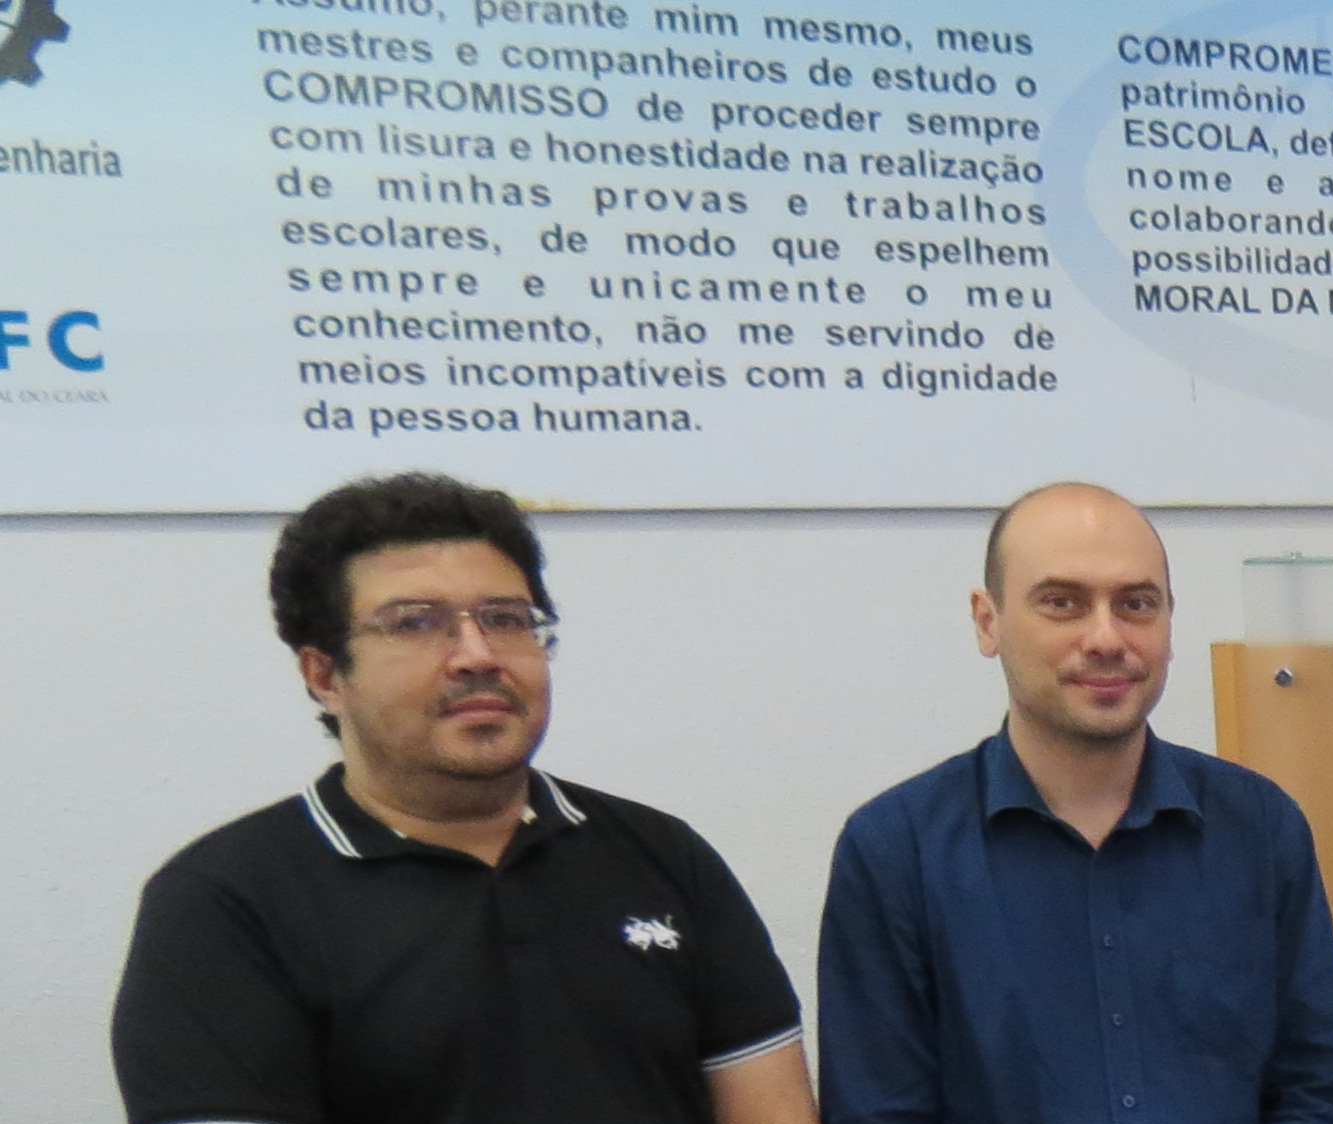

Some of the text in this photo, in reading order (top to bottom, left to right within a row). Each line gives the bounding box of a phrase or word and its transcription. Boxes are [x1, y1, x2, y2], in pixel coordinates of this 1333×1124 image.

[475, 0, 628, 29] perante
[655, 4, 738, 36] mim
[764, 17, 912, 51] mesmo,
[937, 28, 1033, 55] meus
[258, 29, 1037, 98] mestres e companheiros de estudo o
[263, 69, 1040, 145] COMPROMISSO de proceder sempre
[1121, 81, 1305, 115] patrimônio
[270, 124, 1043, 189] com lisura e honestidade na realização
[1124, 118, 1278, 158] ESCOLA,
[276, 166, 1046, 225] de minhas provas e trabalhos
[1127, 168, 1231, 192] nome
[1267, 174, 1284, 194] e
[281, 217, 1049, 271] escolares, de modo que espelhem
[288, 268, 1051, 309] sempre e unicamente o meu
[1135, 284, 1261, 313] MORAL
[1272, 287, 1319, 315] DA
[293, 309, 1054, 350] conhecimento, não me servindo de
[299, 354, 1057, 397] meios incompatíveis com a dignidade
[304, 400, 702, 438] da pessoa humana.
